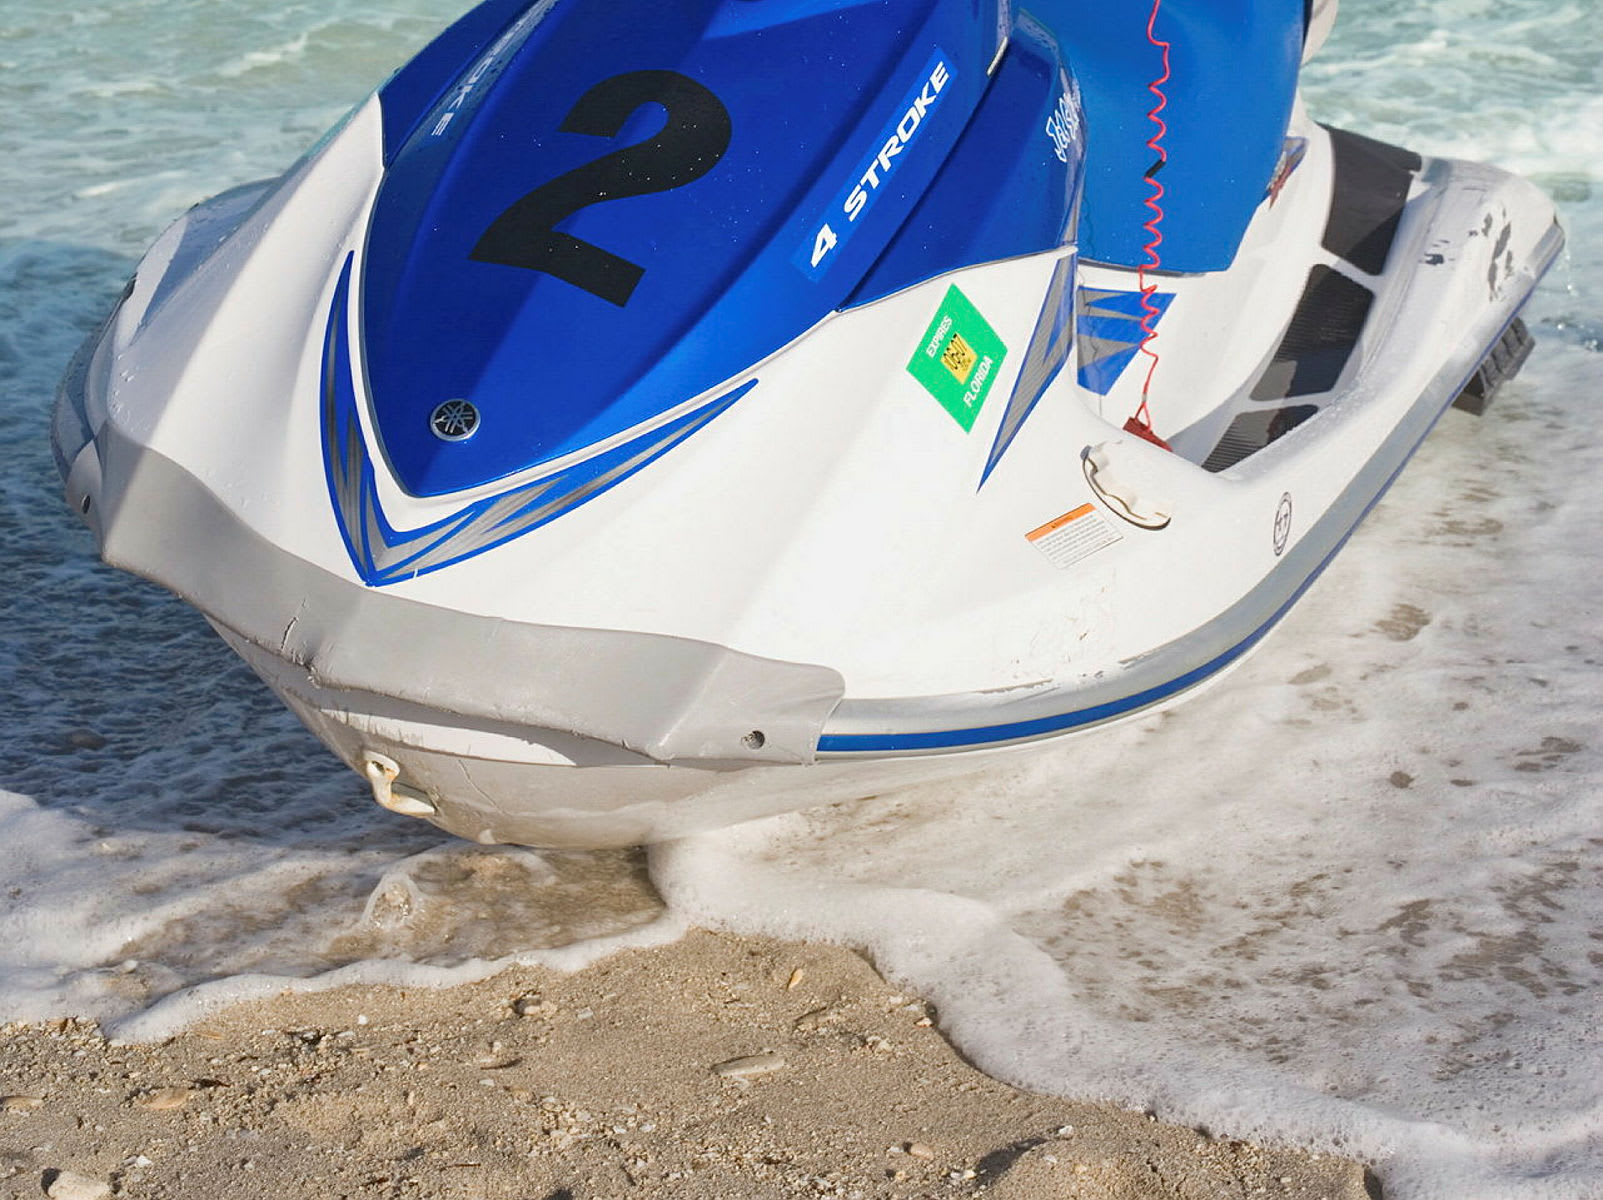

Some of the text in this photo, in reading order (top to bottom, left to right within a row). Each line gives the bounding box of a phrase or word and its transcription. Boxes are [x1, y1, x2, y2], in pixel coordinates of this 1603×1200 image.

[467, 69, 732, 308] 2
[810, 61, 949, 268] 4 STROKE
[926, 315, 953, 358] EXPIRES
[963, 355, 994, 408] FLORIDA
